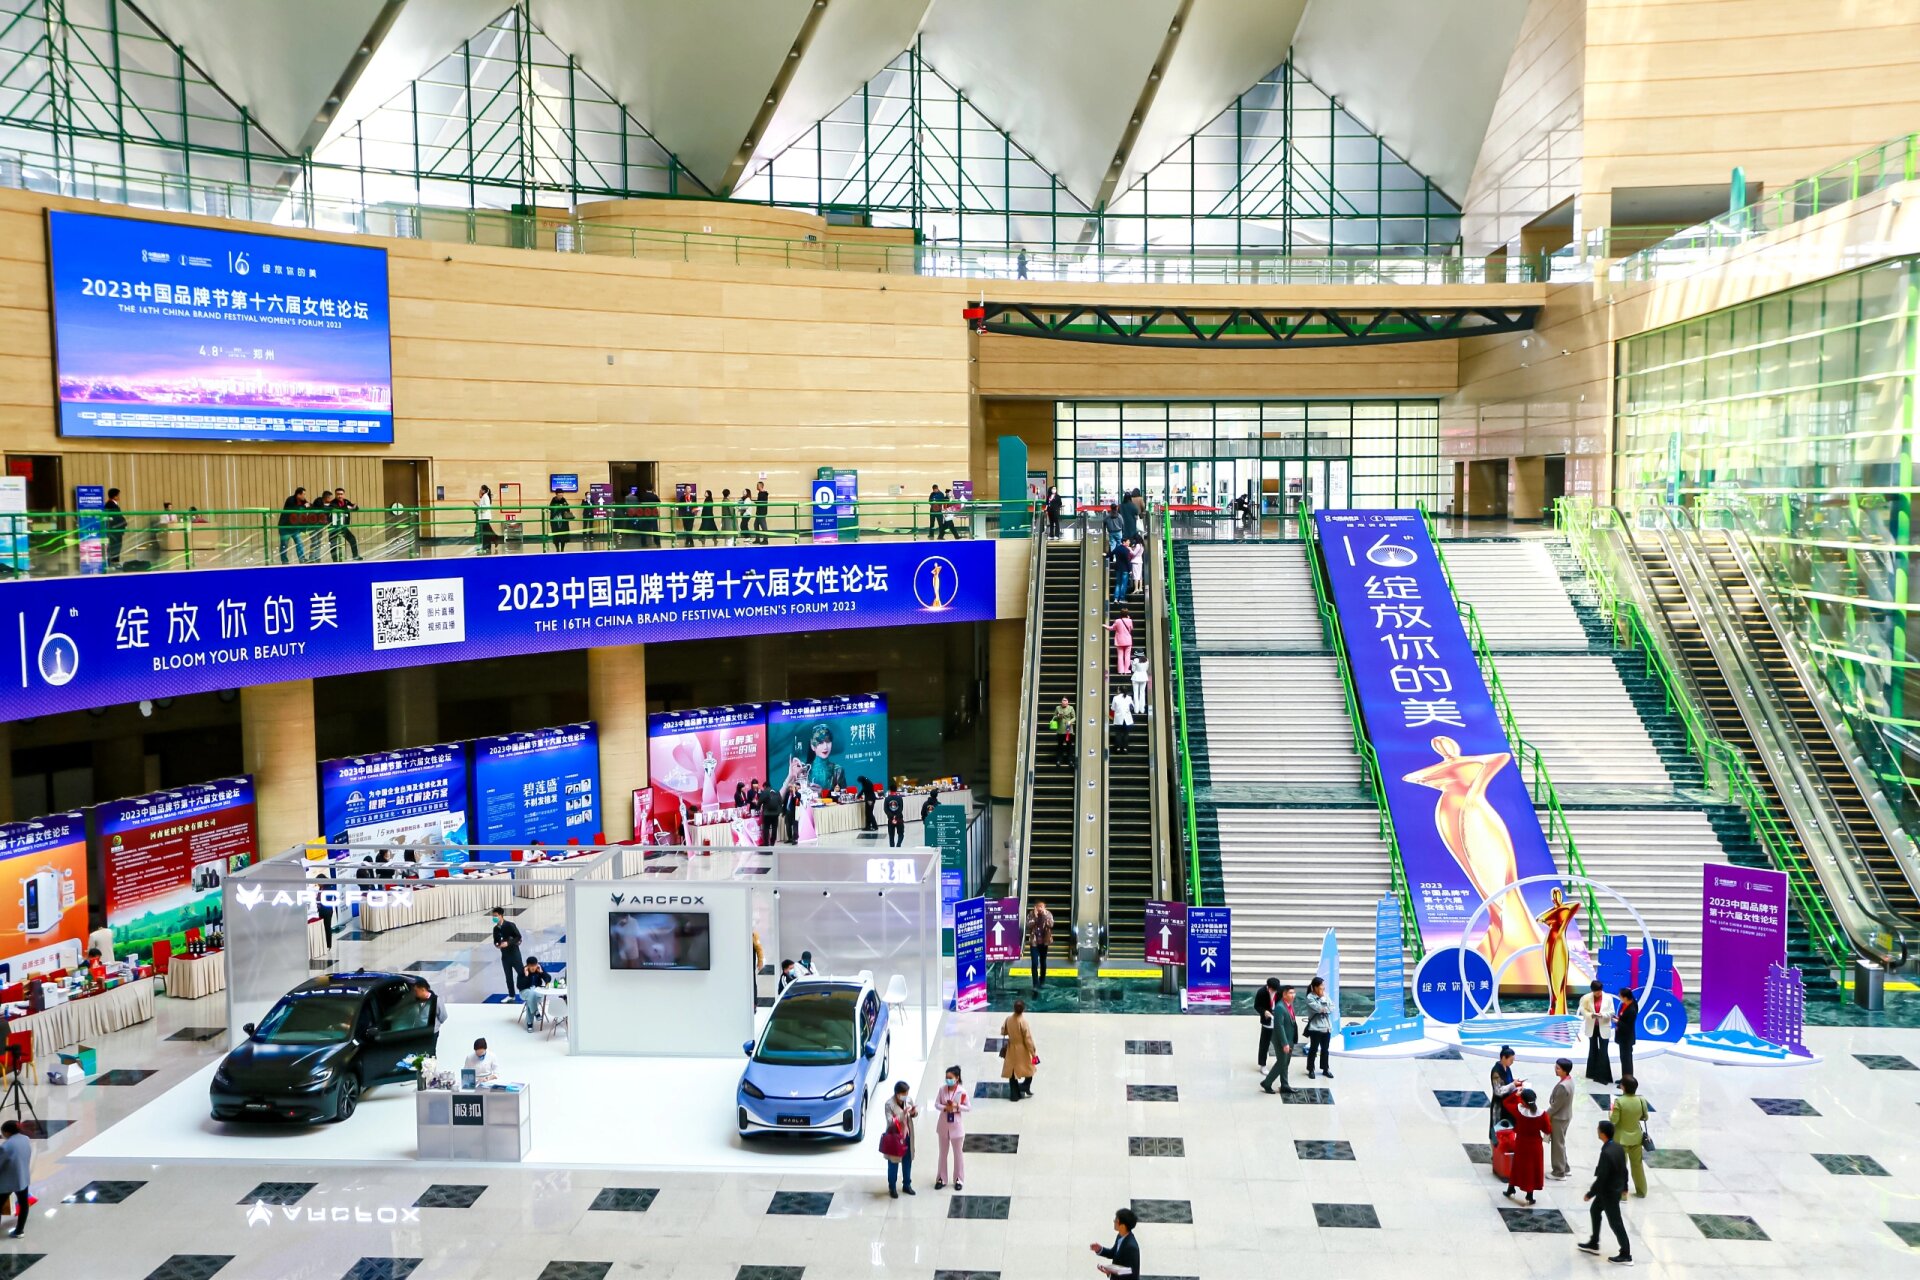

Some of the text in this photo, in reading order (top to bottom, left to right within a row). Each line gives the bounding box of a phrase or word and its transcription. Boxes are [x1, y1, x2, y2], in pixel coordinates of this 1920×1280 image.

[81, 277, 369, 320] 2023中国品牌节第十六届女性论坛
[118, 303, 342, 329] THE 16TH CHINA BRAND FESTIVAL WOMEN'S FORUM 2023
[426, 592, 455, 603] 电子议程
[497, 564, 889, 612] 2023中国品牌节第十六届女性论坛
[115, 590, 339, 650] 绽放你的美
[427, 607, 456, 618] 图片直播
[534, 600, 856, 632] THE 16TH CHINA BRAND FESTIVAL WOMEN'S FORUM 2023
[427, 620, 456, 632] 视频直播
[153, 641, 306, 671] BLOOM YOUR BEAUTY
[1363, 575, 1467, 728] 绽放你的美
[120, 788, 240, 821] 2023中国品牌节第十六届女性论坛
[368, 788, 449, 811] 提供一站式解决方案
[271, 889, 413, 908] ARCFOX
[629, 895, 705, 906] ARCFOX
[1709, 896, 1779, 915] 2023中国品牌节
[1709, 907, 1779, 926] 第十六届女性论坛
[1200, 947, 1218, 957] D区
[454, 1103, 482, 1117] 极狐
